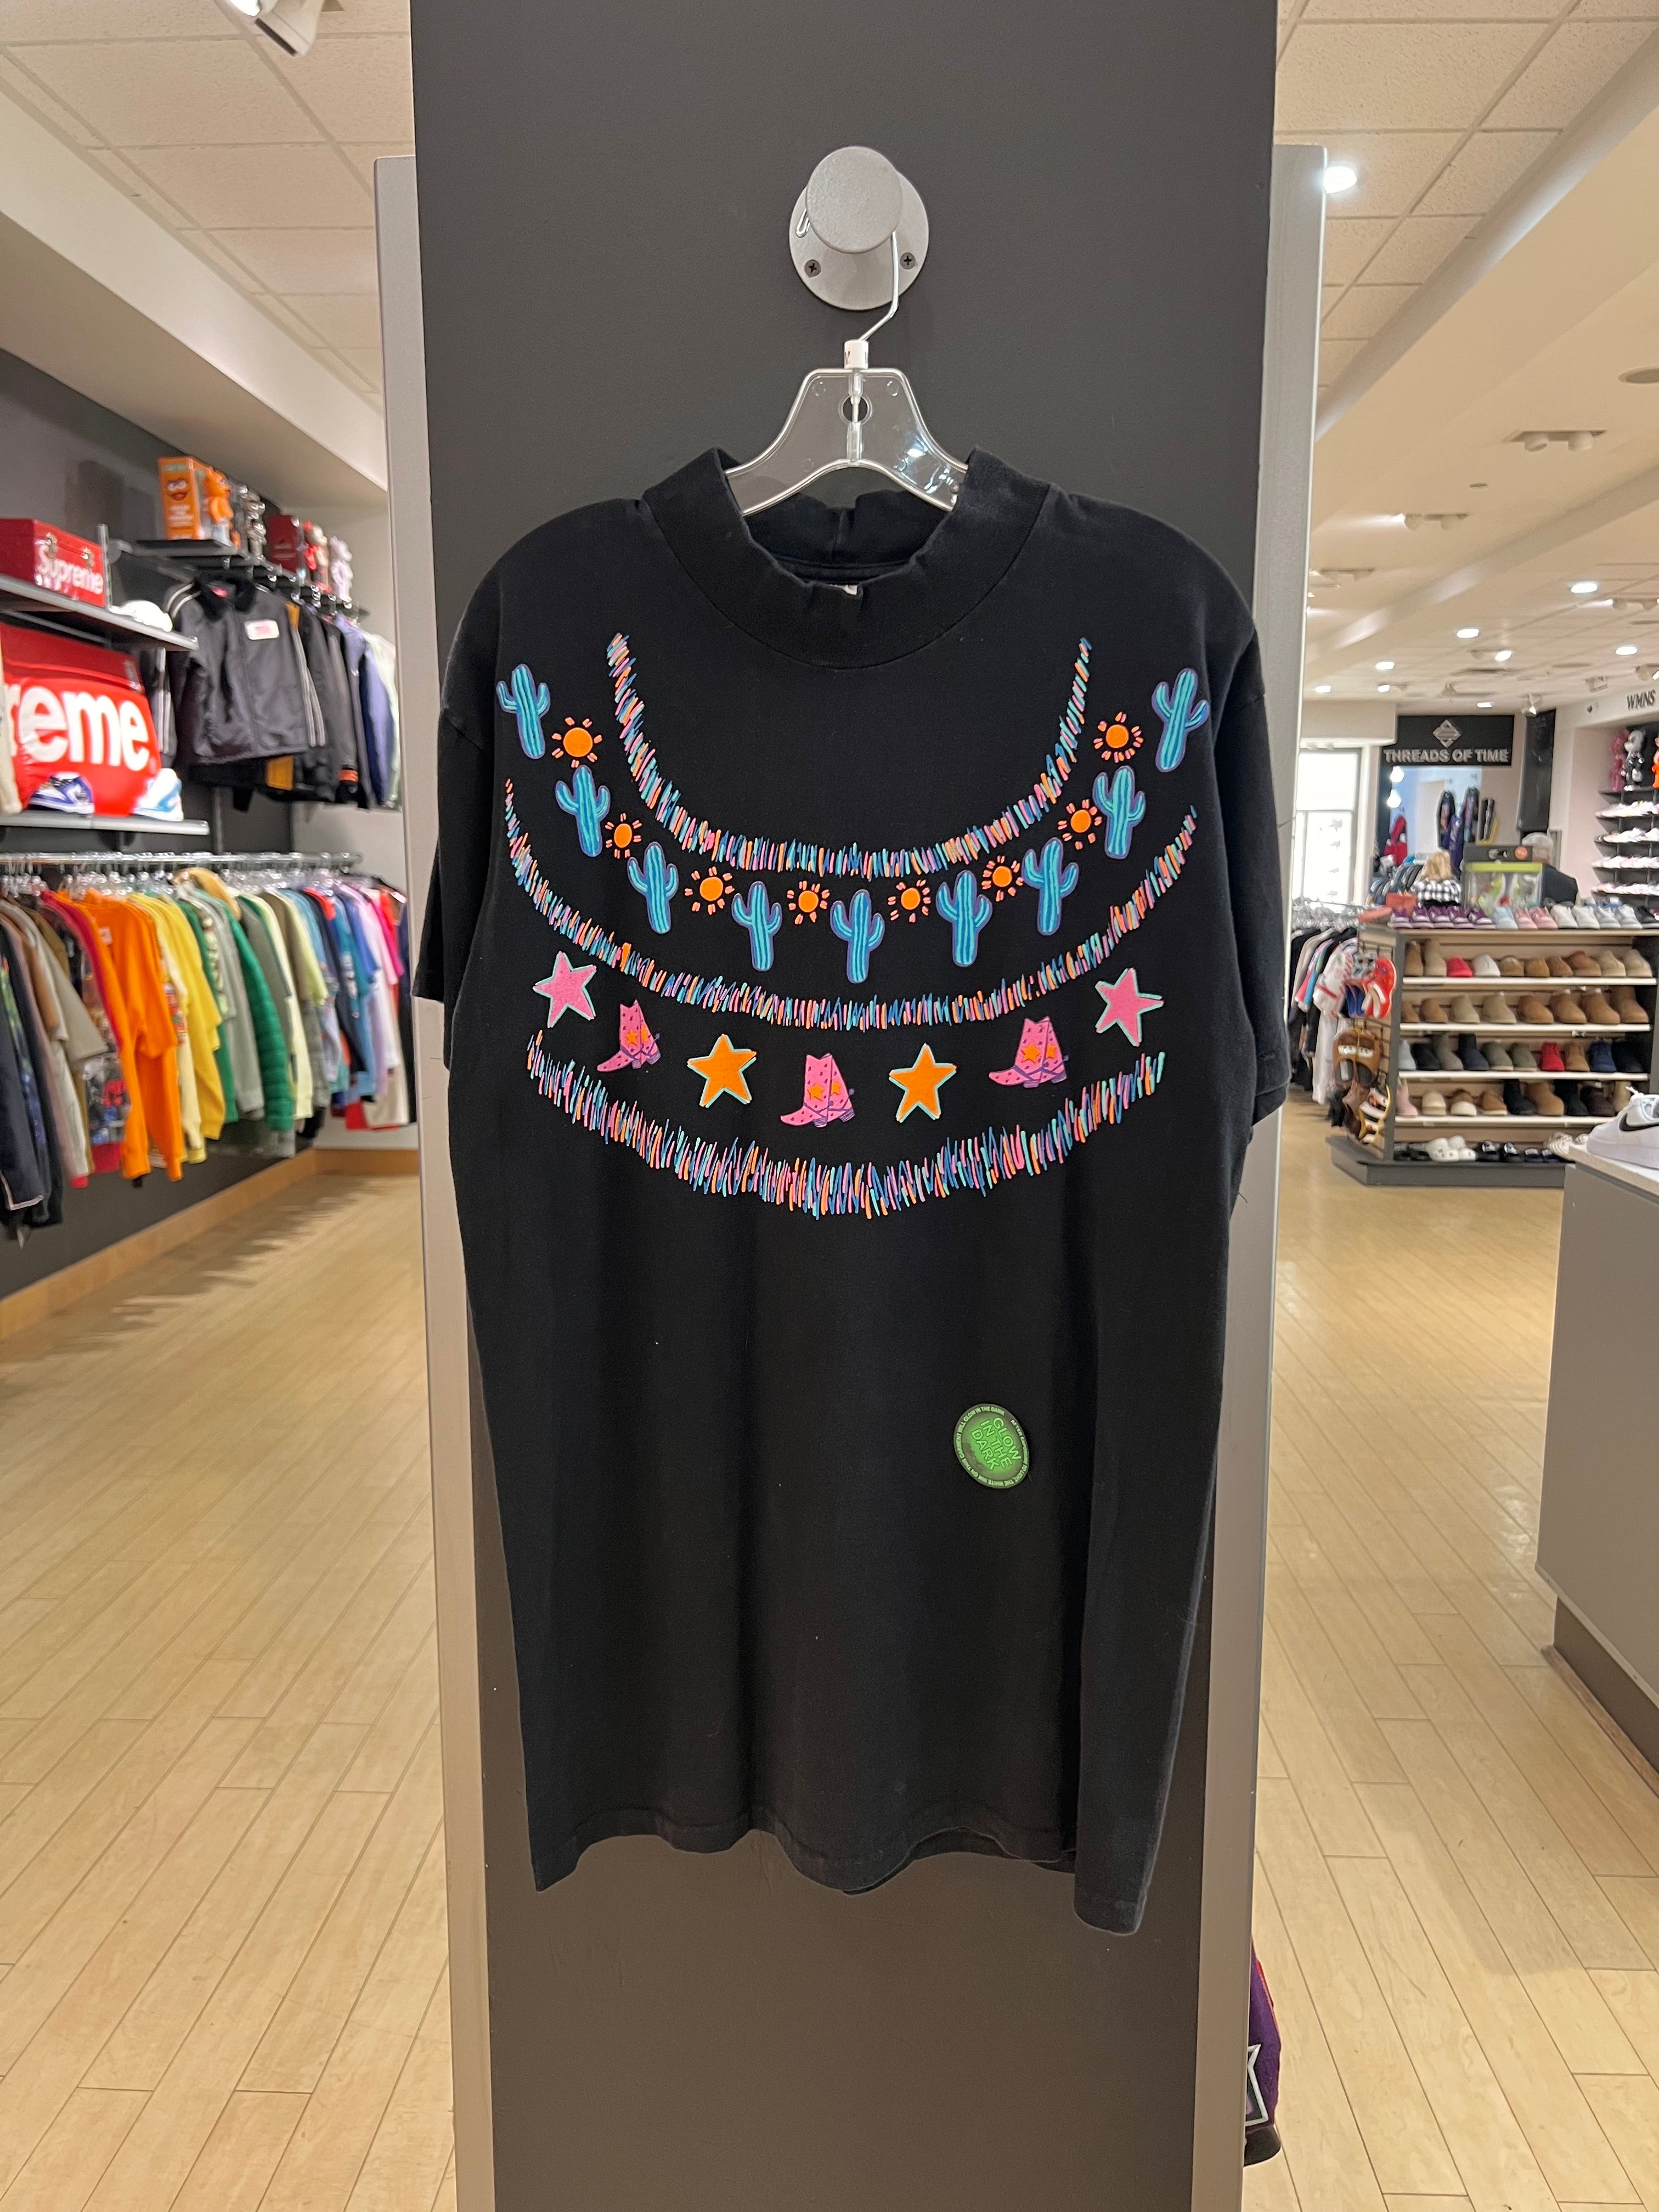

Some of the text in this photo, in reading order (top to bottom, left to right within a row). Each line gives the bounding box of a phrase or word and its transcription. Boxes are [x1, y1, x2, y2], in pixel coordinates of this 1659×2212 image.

[36, 544, 104, 595] Supreme
[1627, 689, 1656, 710] WMNS
[1383, 748, 1509, 763] THREADS OF TIME
[963, 1410, 976, 1422] GLOW
[972, 1429, 999, 1470] DARK
[980, 1420, 1012, 1468] IN THE
[993, 1417, 1022, 1459] GLOW
[970, 1469, 978, 1477] ON
